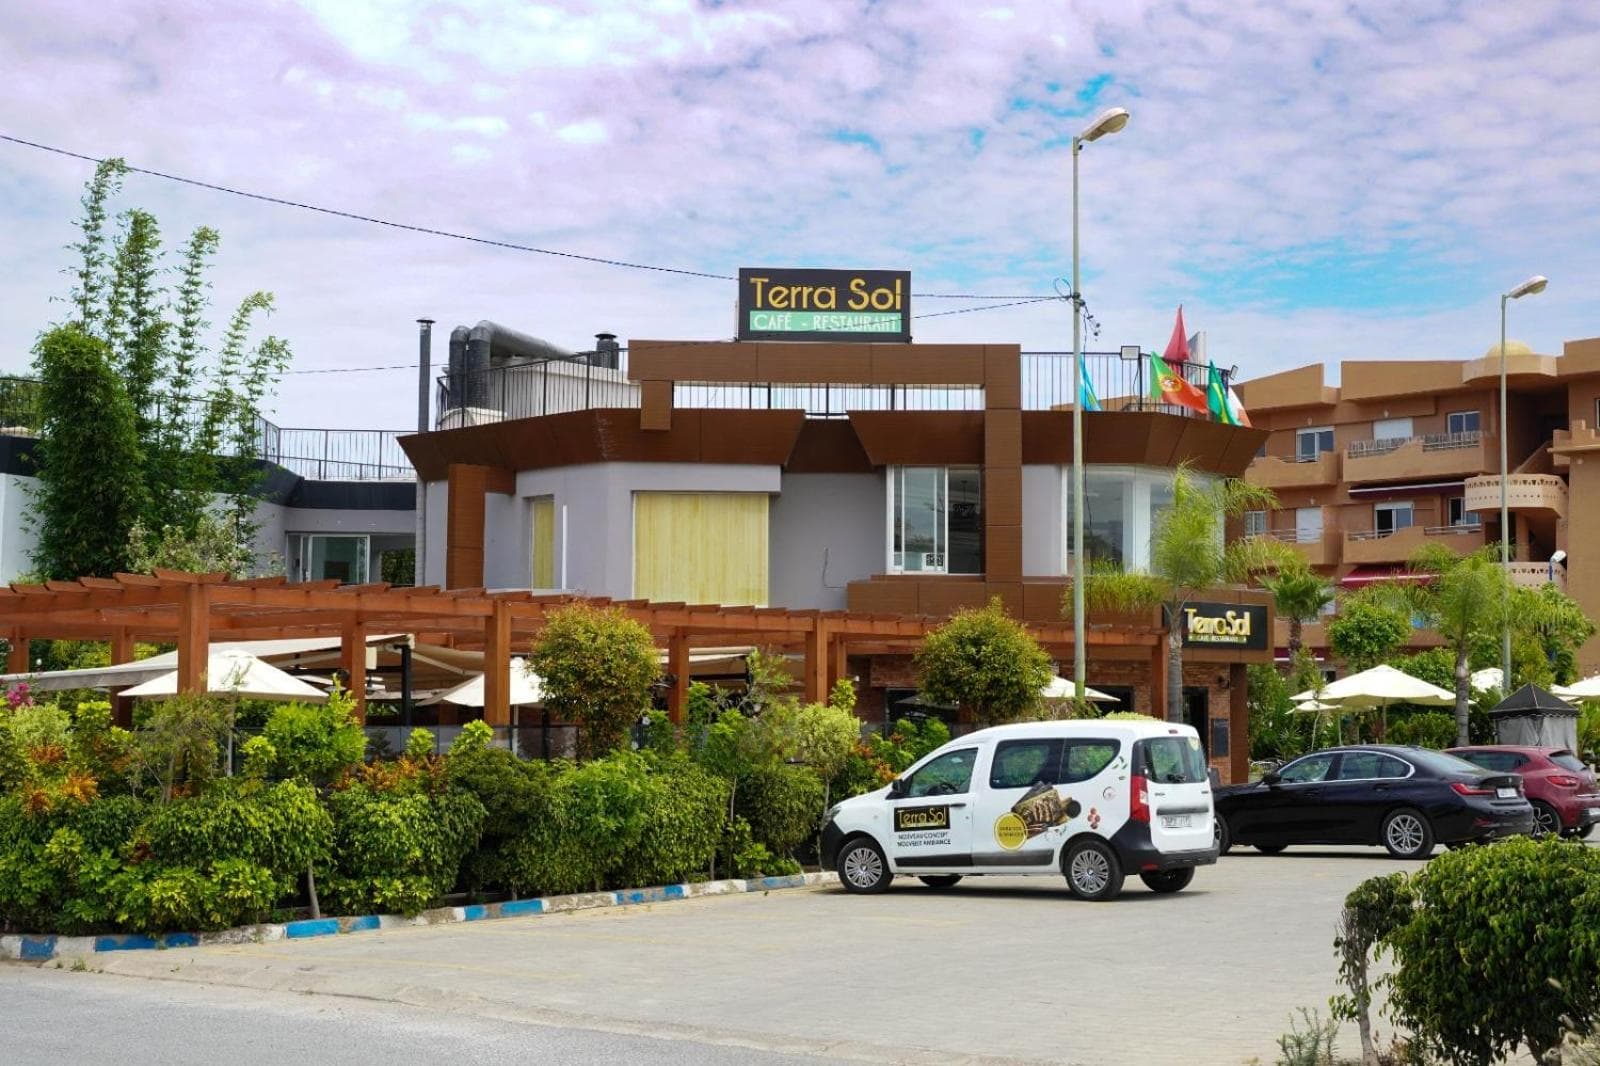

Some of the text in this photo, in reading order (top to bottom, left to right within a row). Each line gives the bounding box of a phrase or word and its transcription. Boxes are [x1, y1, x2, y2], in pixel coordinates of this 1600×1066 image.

[750, 277, 902, 311] Terra Sol
[813, 314, 898, 332] RESTAURANT
[897, 806, 946, 825] Terra Sol
